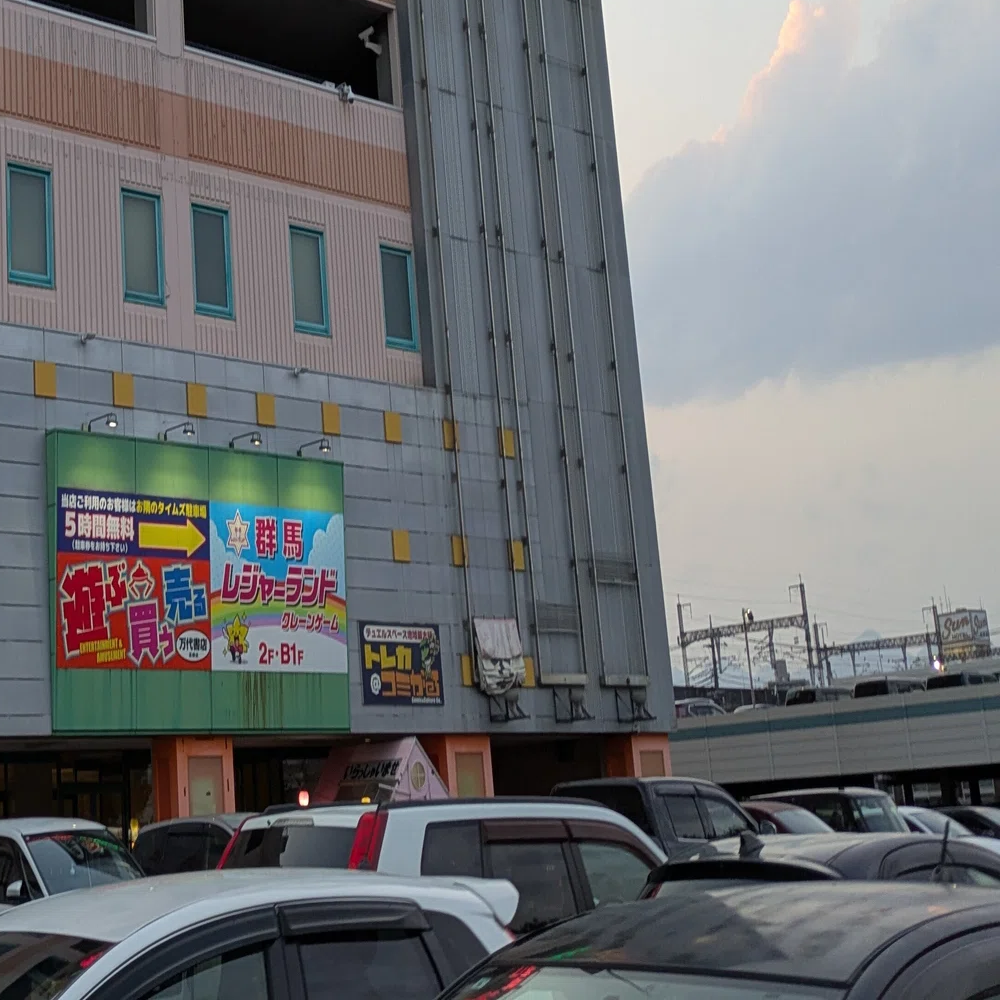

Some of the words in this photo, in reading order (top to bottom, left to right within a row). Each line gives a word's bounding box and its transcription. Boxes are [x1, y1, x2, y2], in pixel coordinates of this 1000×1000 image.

[64, 511, 135, 542] 5時間無料
[254, 516, 303, 560] 群馬
[163, 566, 207, 621] 売る
[221, 563, 339, 608] レジャーランド
[127, 602, 176, 664] 買う
[281, 611, 339, 633] クレーンゲーム
[942, 616, 970, 640] Sun
[179, 637, 207, 651] 万代書店
[364, 643, 412, 670] トレカ
